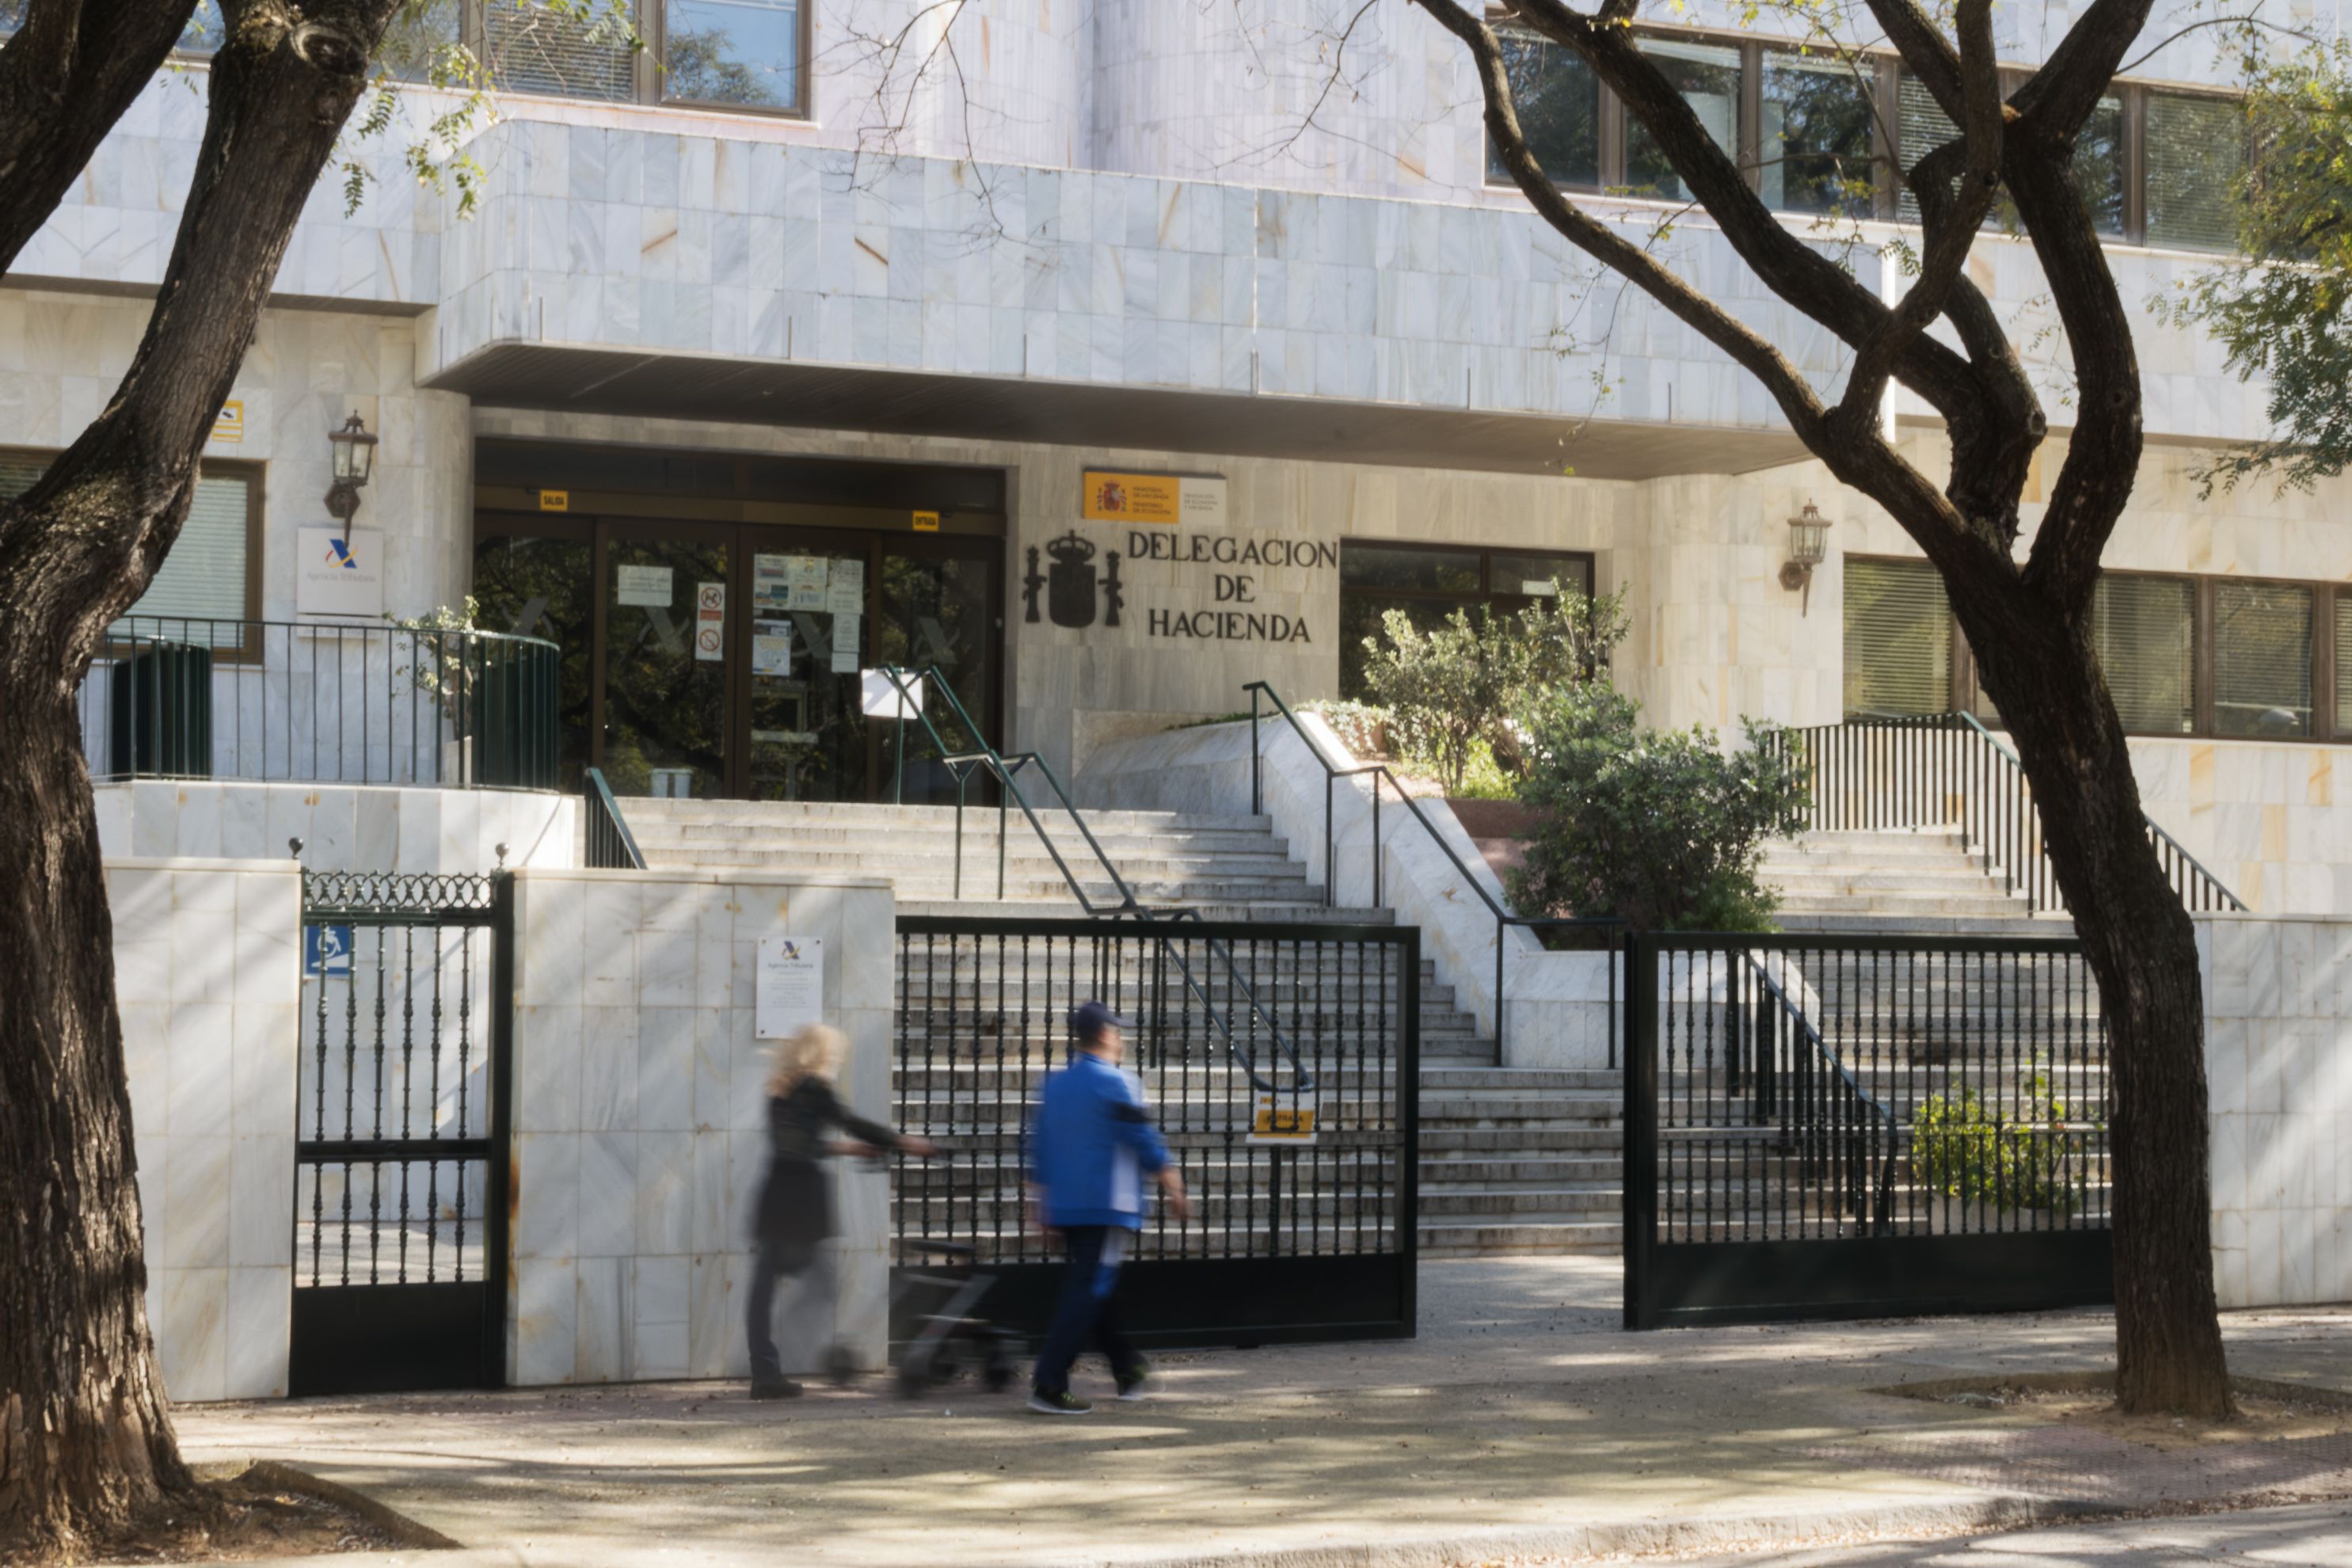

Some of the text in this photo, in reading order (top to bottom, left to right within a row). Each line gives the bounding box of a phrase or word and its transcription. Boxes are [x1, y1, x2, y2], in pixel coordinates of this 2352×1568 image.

[1128, 531, 1337, 569] DELEGACION
[306, 573, 337, 582] Agencia
[1214, 574, 1256, 603] DE
[1148, 609, 1311, 642] HACIENDA
